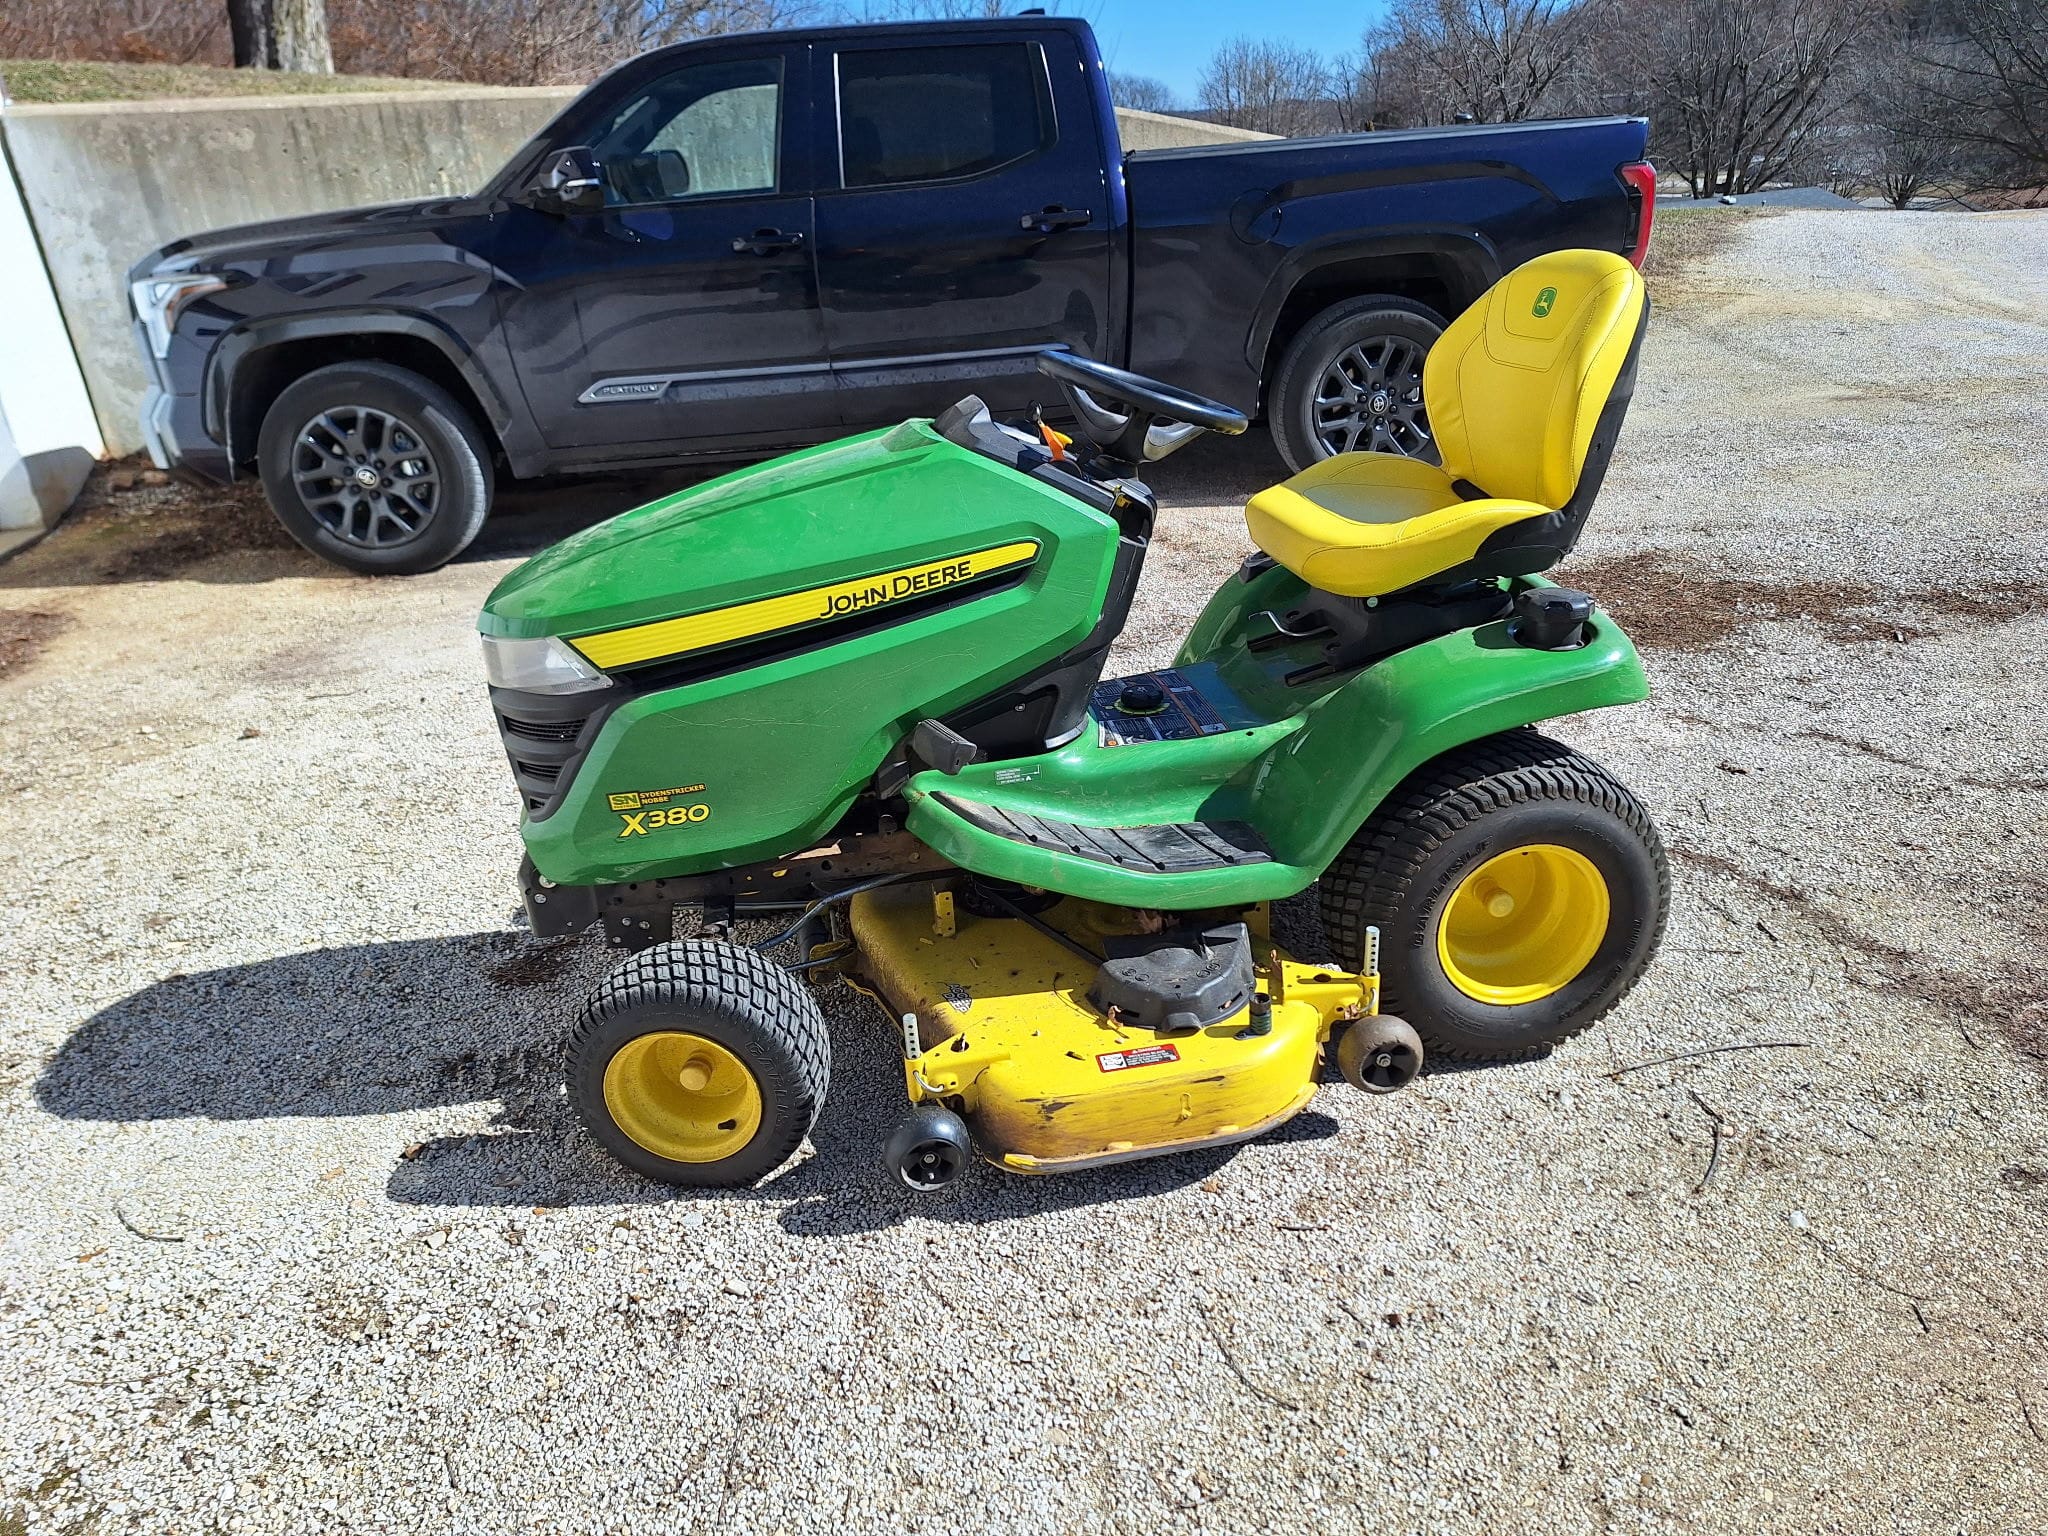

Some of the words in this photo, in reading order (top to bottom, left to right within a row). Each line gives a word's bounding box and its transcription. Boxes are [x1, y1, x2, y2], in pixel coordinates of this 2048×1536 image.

[603, 384, 658, 394] PLATINUM
[820, 584, 887, 617] JOHN
[893, 560, 972, 596] DEERE
[640, 784, 705, 799] SYDENSTRICKER
[612, 794, 638, 806] SN
[641, 796, 669, 805] NOBBE
[620, 804, 710, 838] X380
